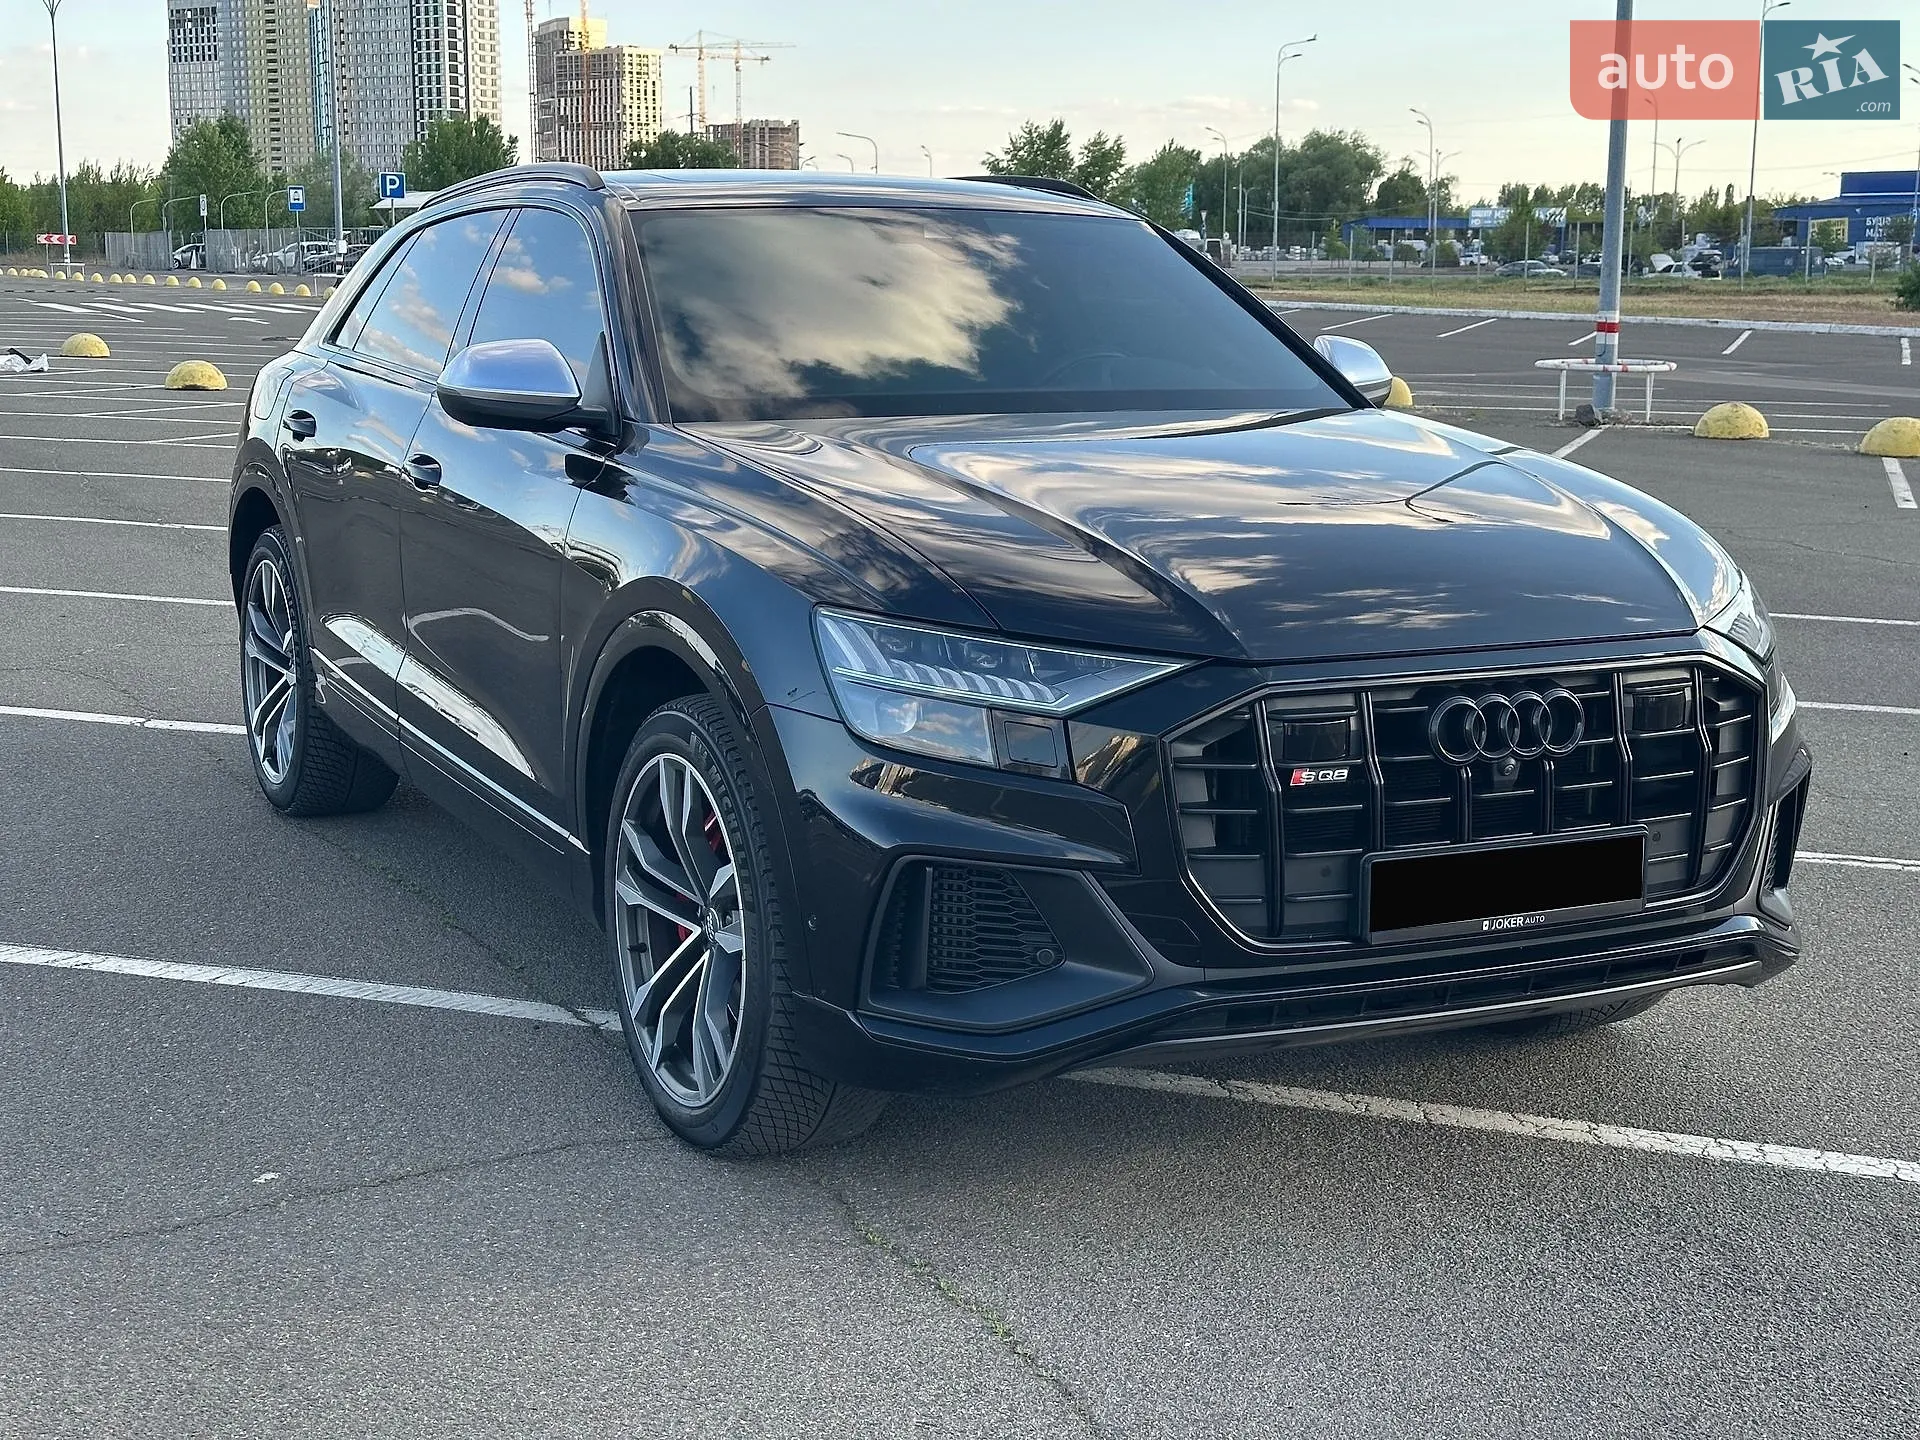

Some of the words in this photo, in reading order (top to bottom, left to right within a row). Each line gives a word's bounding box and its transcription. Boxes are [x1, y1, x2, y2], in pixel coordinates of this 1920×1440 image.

[386, 175, 399, 196] P
[1297, 769, 1349, 783] SQ8
[1491, 916, 1524, 930] JOKER
[1525, 915, 1545, 925] AUTO
